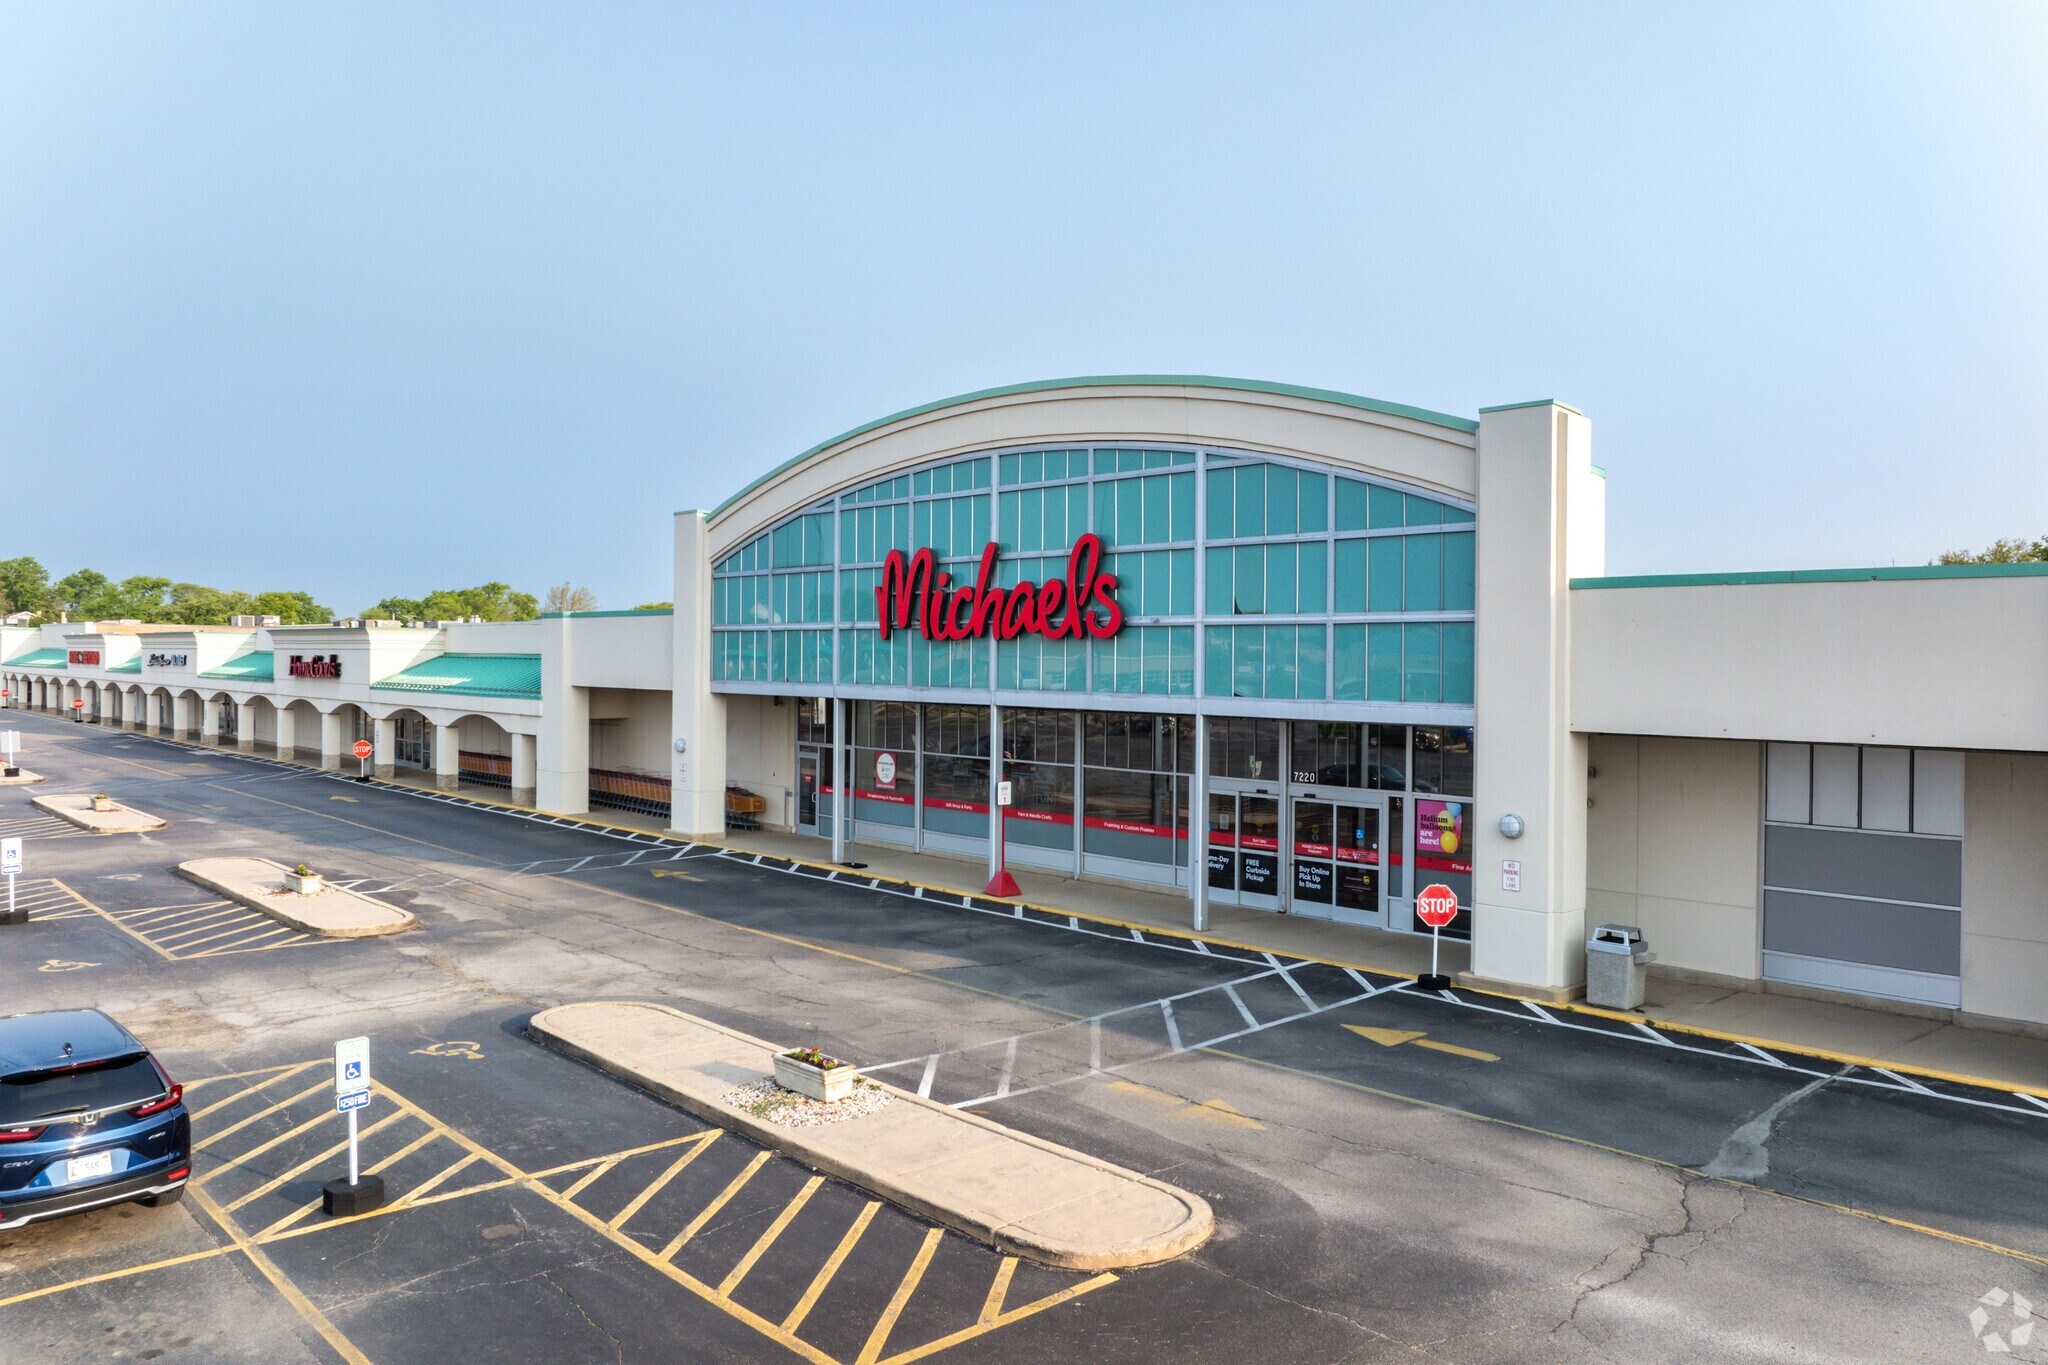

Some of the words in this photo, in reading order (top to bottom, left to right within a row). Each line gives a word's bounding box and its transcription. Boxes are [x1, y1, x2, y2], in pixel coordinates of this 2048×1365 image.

[875, 533, 1122, 641] Michaels
[354, 745, 371, 753] STOP
[1293, 771, 1315, 783] 7220
[1420, 815, 1448, 823] Helium
[1104, 821, 1120, 829] Framing
[1420, 836, 1440, 845] here!
[1246, 859, 1260, 867] FREE
[1246, 866, 1270, 875] Curbside
[1299, 865, 1310, 874] Buy
[1311, 867, 1330, 876] Online
[1246, 873, 1264, 882] Pickup
[1305, 881, 1321, 889] Store
[1420, 898, 1454, 914] STOP
